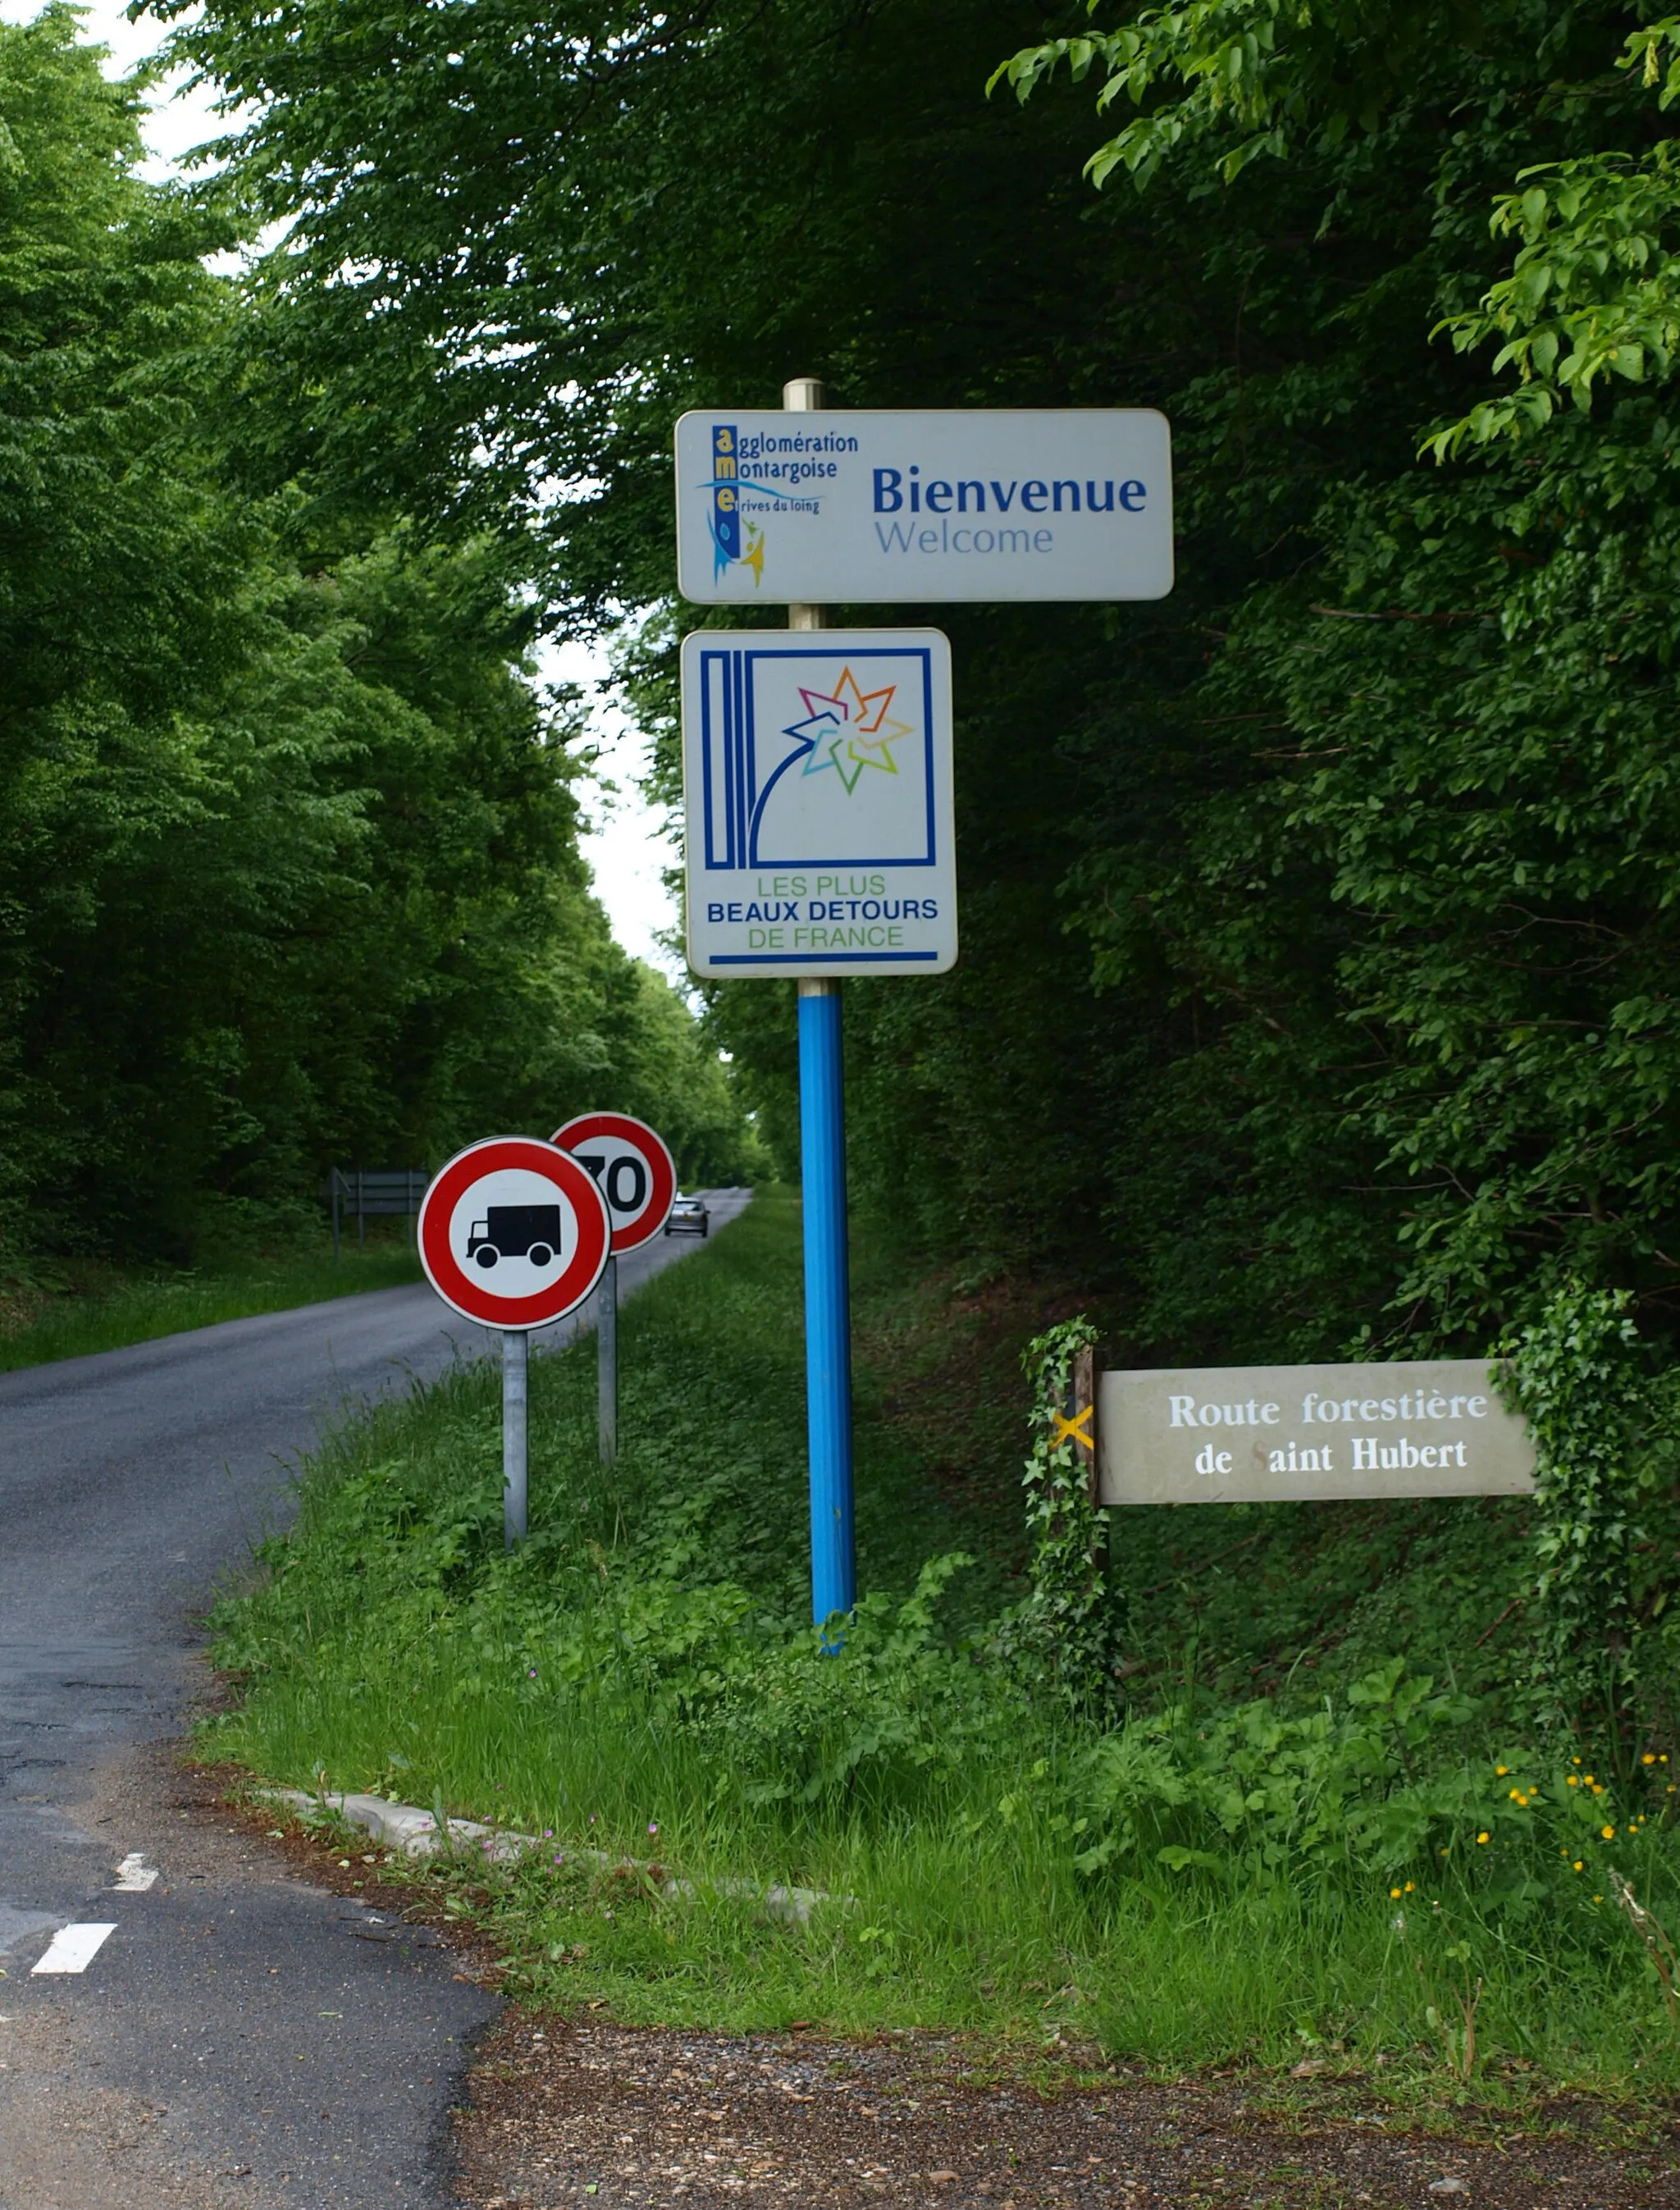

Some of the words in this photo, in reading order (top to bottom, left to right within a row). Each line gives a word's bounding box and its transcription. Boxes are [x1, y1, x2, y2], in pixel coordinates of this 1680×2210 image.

[716, 428, 858, 459] agglomération
[715, 456, 838, 484] montargoise
[872, 465, 1148, 514] Bienvenue
[742, 499, 770, 513] rives
[774, 498, 788, 513] du
[791, 498, 819, 515] loing
[874, 518, 1054, 555] Welcome
[758, 876, 808, 898] LES
[817, 874, 887, 897] PLUS
[708, 902, 799, 923] BEAUX
[809, 899, 939, 922] DETOURS
[749, 928, 784, 949] DE
[794, 925, 904, 948] FRANCE
[1169, 1395, 1281, 1428] Route
[1302, 1387, 1488, 1424] forestière
[1194, 1443, 1232, 1474] de
[1351, 1437, 1468, 1471] Hubert
